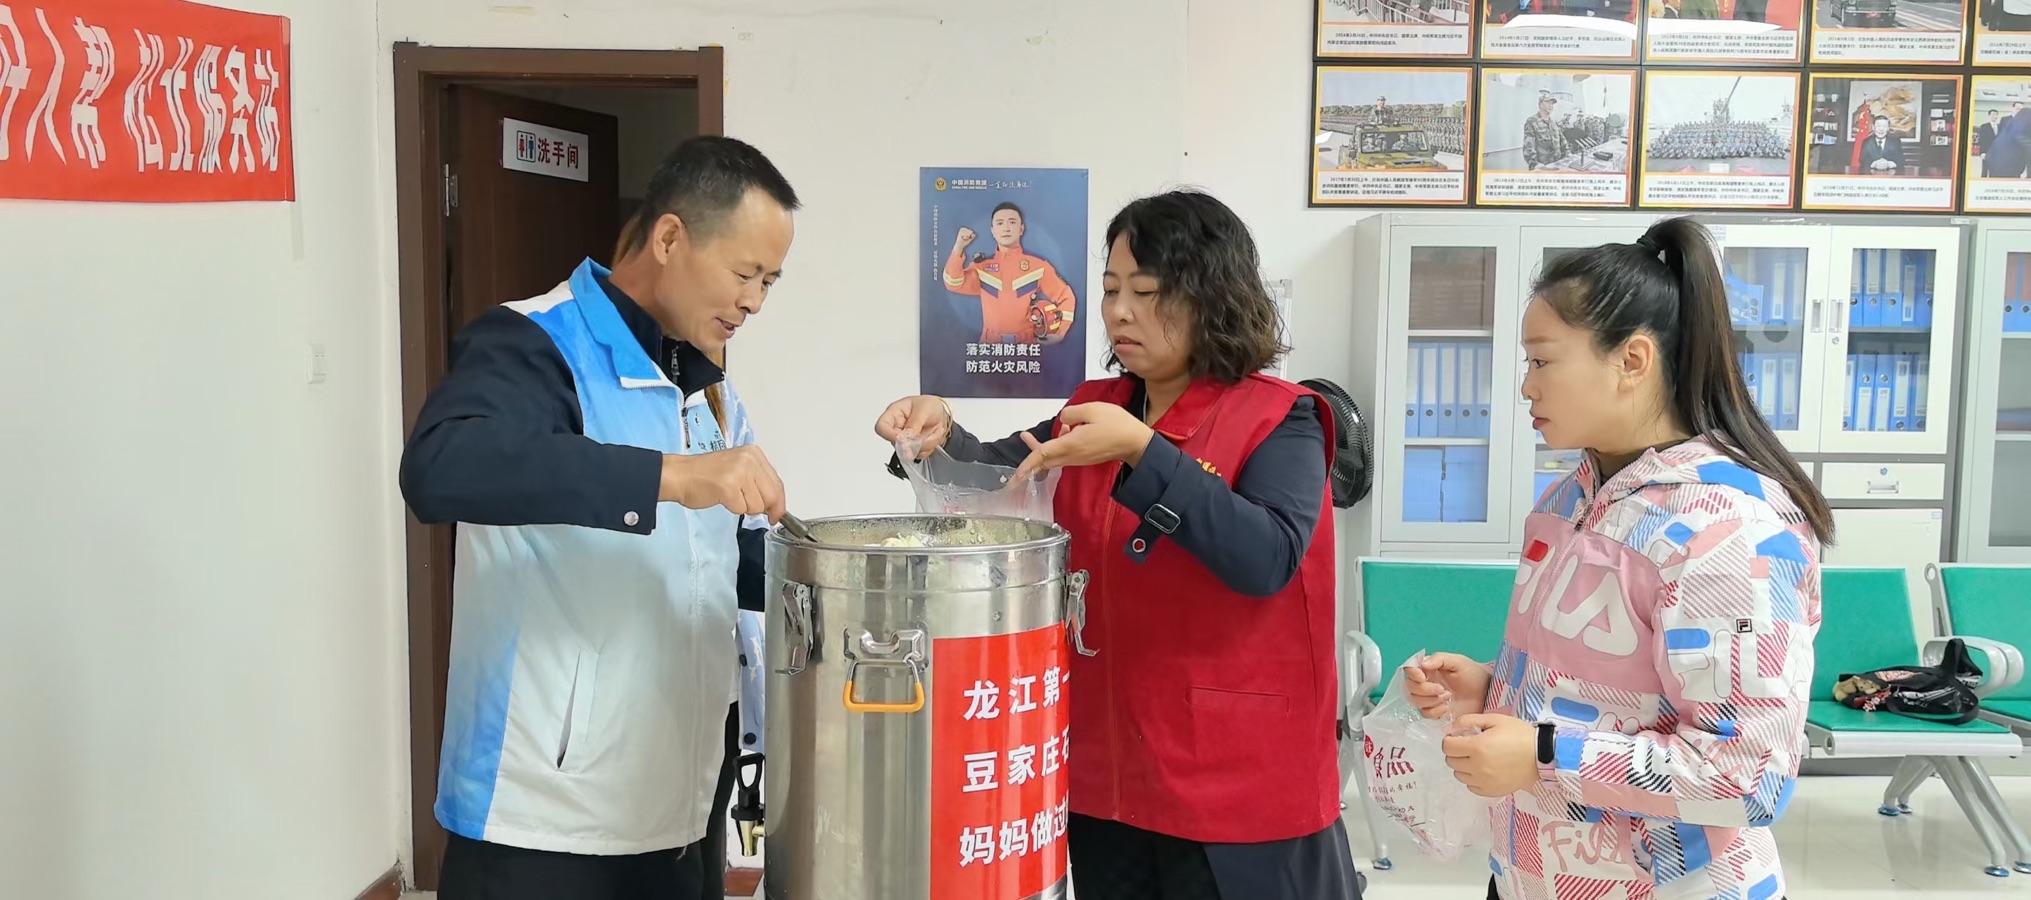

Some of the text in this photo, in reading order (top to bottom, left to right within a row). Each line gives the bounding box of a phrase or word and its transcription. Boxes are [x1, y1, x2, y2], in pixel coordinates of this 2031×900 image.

[124, 28, 280, 174] 松北服务站
[537, 137, 579, 169] 洗手间
[966, 343, 1041, 356] 落实消防责任
[966, 360, 1041, 373] 防范火灾风险
[959, 789, 1069, 867] 妈妈做过
